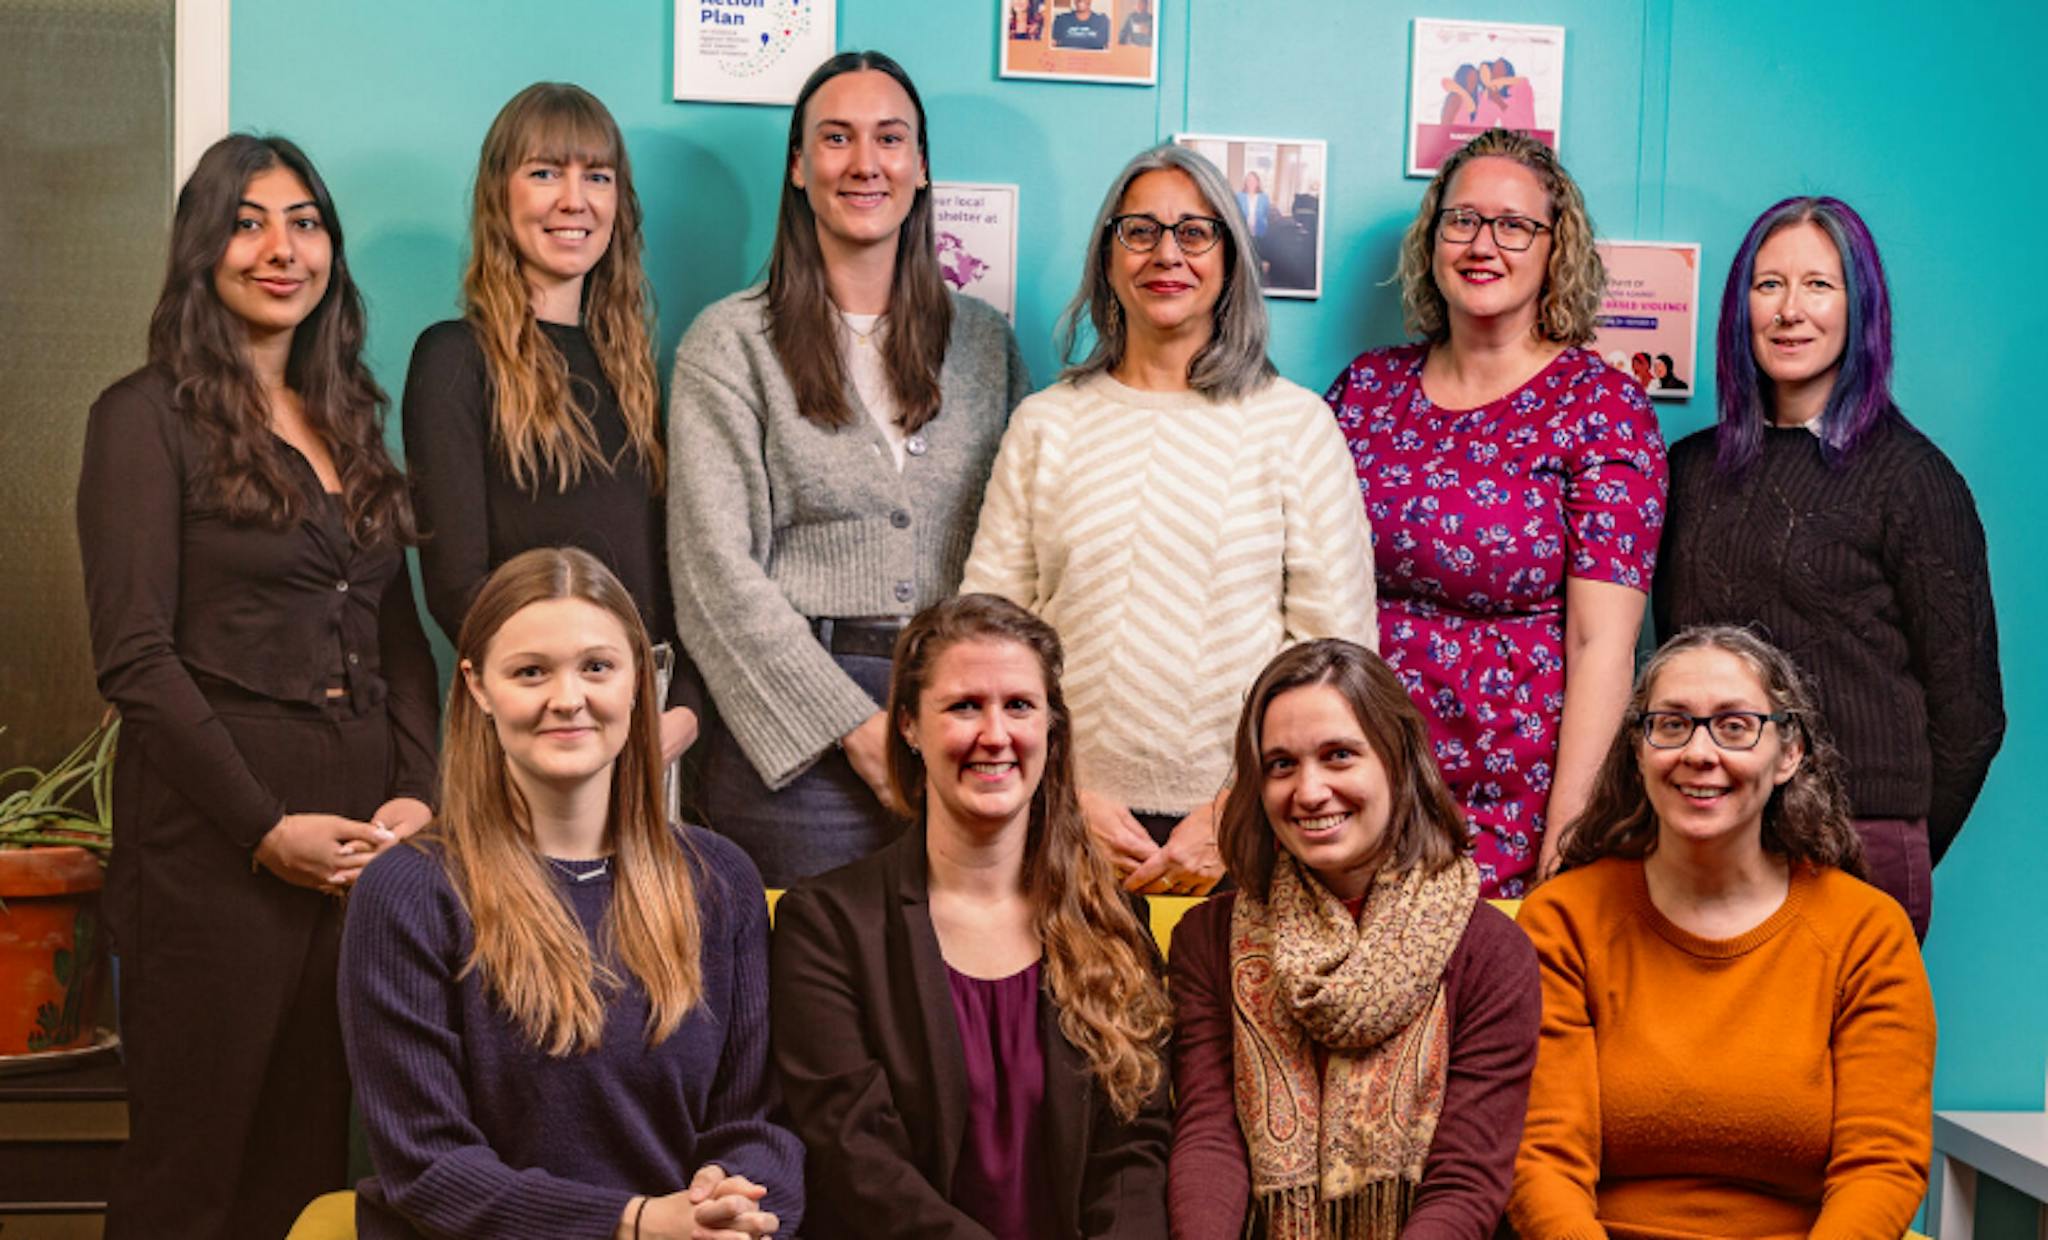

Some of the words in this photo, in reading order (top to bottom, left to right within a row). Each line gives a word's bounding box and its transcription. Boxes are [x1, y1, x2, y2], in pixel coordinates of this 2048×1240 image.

[701, 10, 745, 25] Plan
[955, 196, 985, 206] local
[938, 211, 981, 222] shelter
[985, 214, 997, 223] at
[1641, 302, 1687, 312] VIOLENCE
